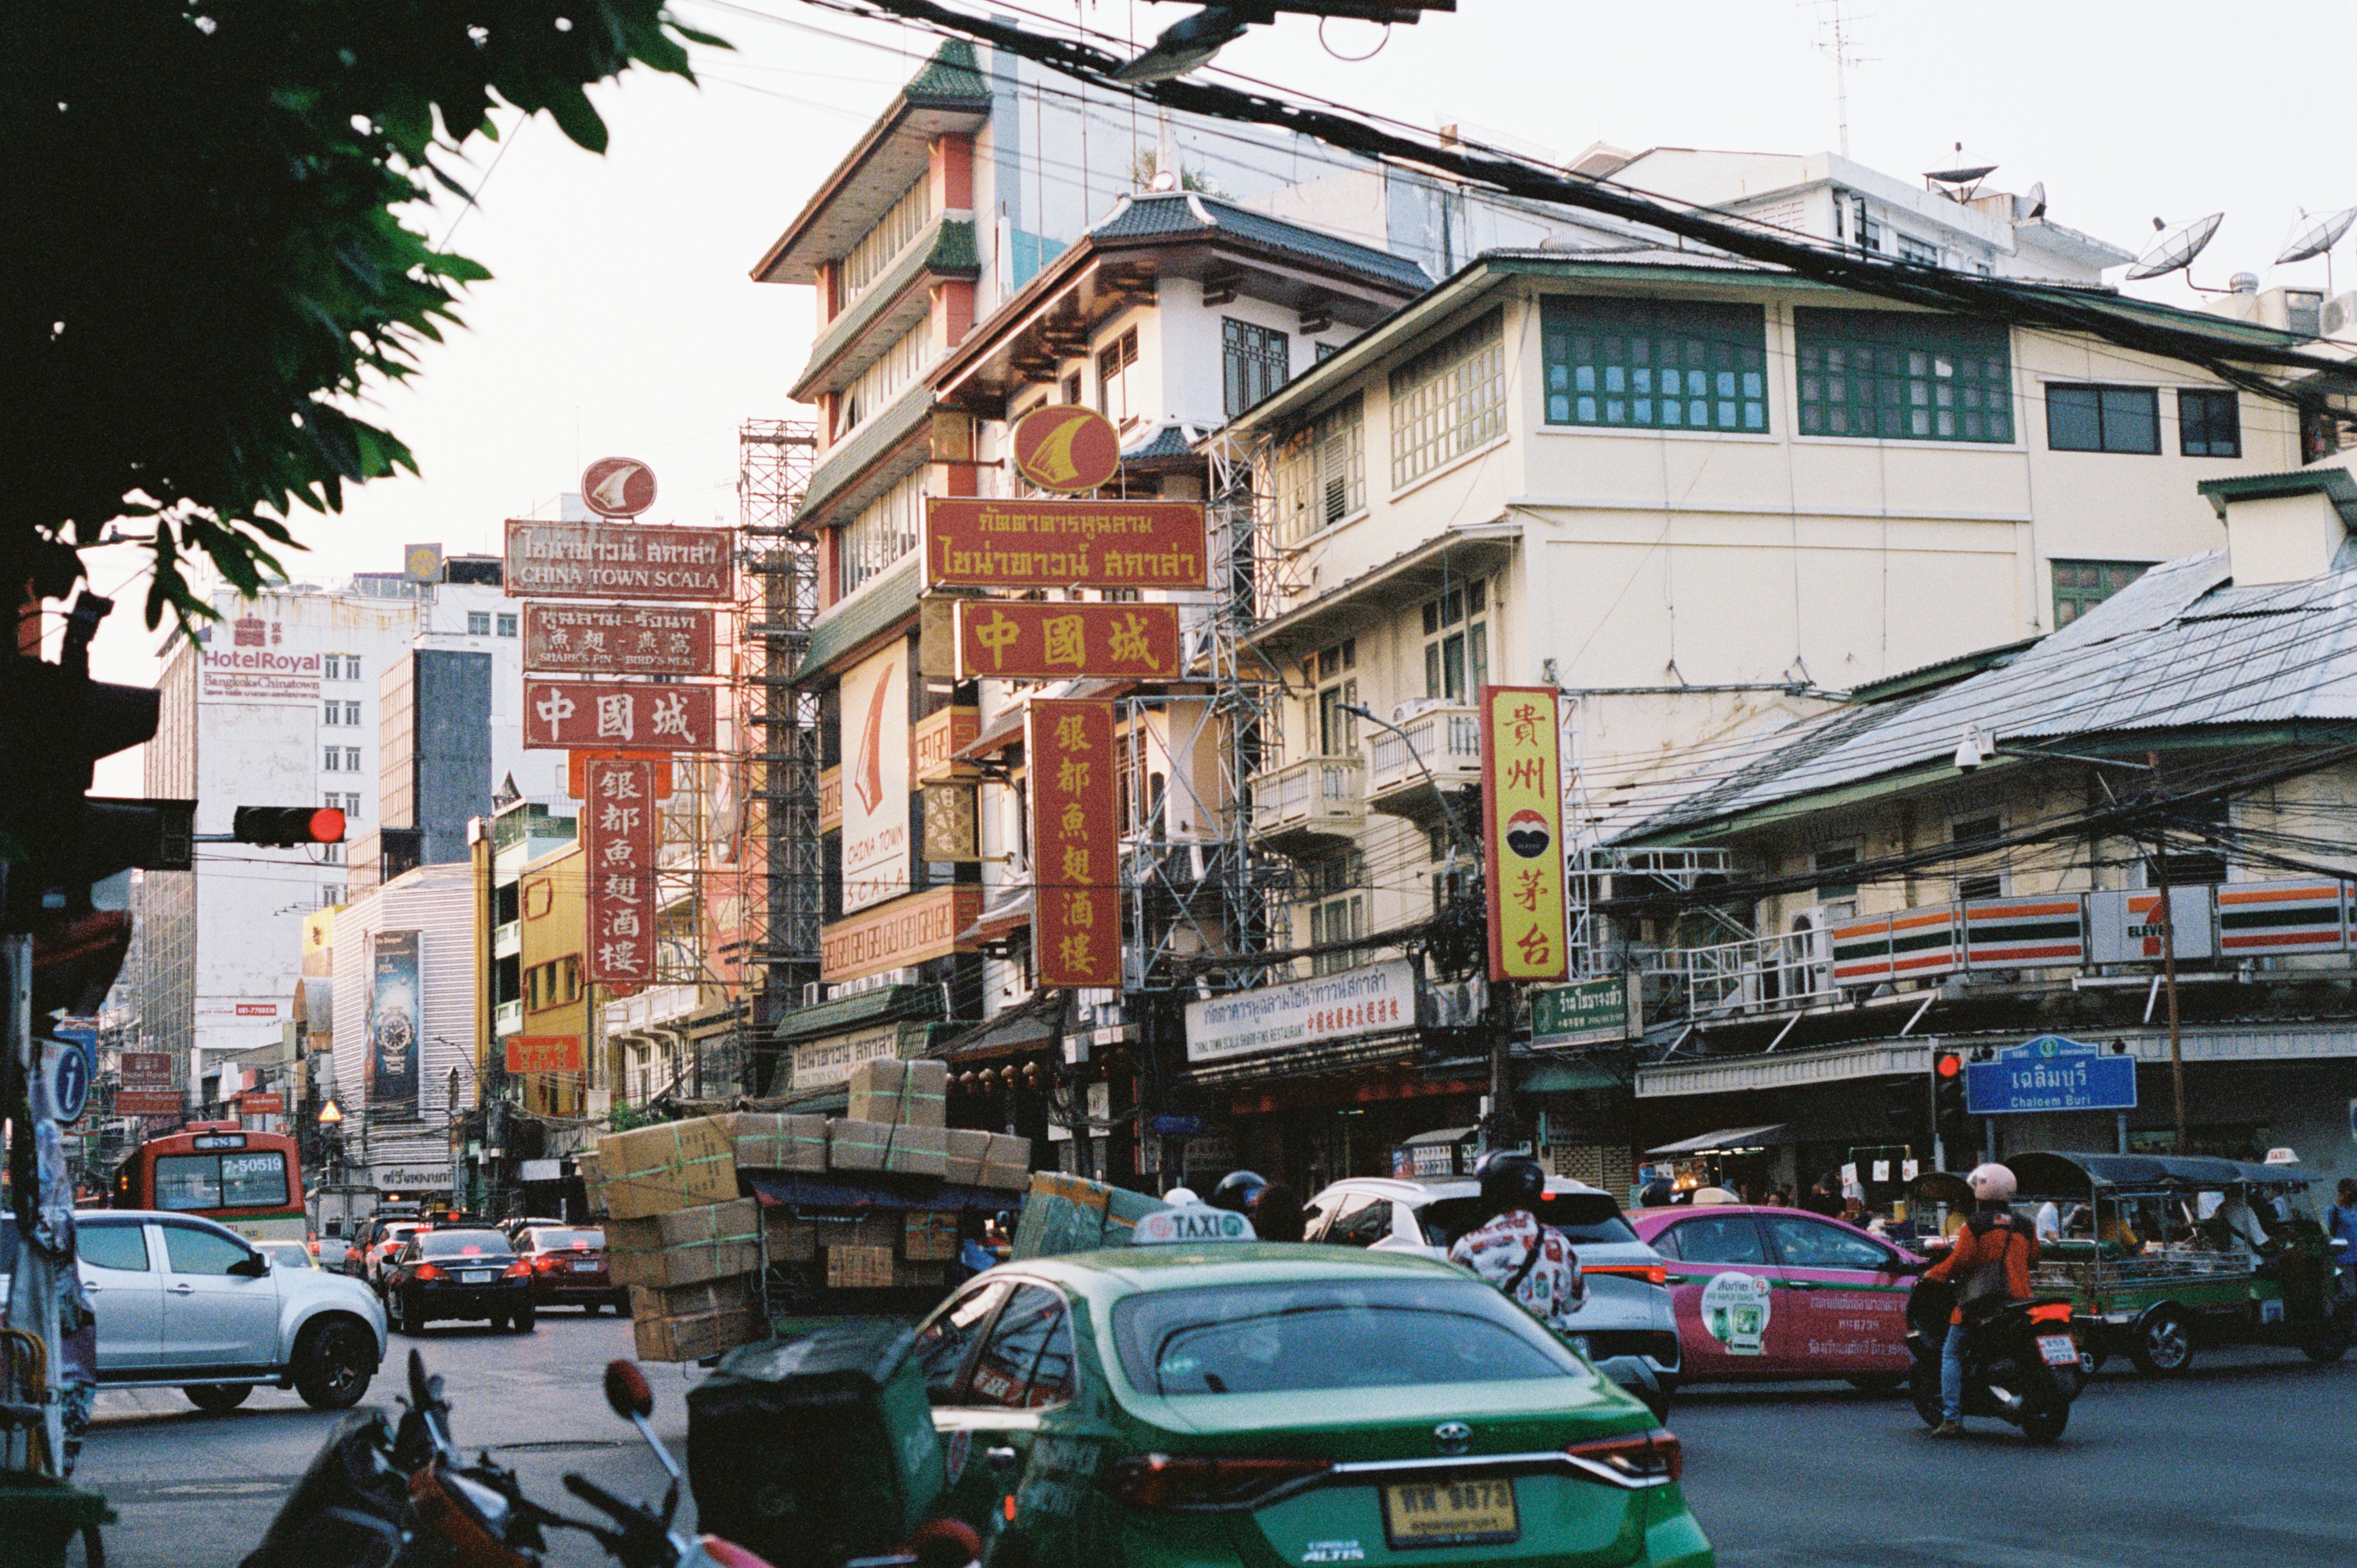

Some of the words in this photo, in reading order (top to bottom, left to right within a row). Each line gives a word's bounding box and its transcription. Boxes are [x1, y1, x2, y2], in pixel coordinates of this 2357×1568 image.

[521, 529, 637, 563] ไชน่าทาวน์
[647, 540, 717, 565] สกาล่า
[937, 536, 1089, 576] ไชน่าทาวน์
[1104, 542, 1196, 576] สกาล่า
[520, 566, 582, 585] CHINA
[590, 568, 650, 587] TOWN
[654, 570, 720, 589] SCALA
[976, 609, 1160, 670] 中國城
[592, 653, 612, 666] FIN
[667, 656, 697, 667] NEST
[535, 687, 697, 744] 中國城
[1502, 703, 1546, 800] 貴州
[847, 835, 876, 867] CHINA
[879, 822, 904, 853] TOWN
[1054, 714, 1097, 976] 銀都魚翅酒樓
[598, 770, 645, 974] 銀都魚翅酒樓
[847, 866, 905, 907] SCALA
[1512, 868, 1551, 967] 茅台
[2128, 922, 2174, 937] ELEVE
[2011, 1060, 2086, 1094] เฉลิมบุรี
[2011, 1096, 2061, 1108] Chaloem
[2066, 1094, 2091, 1106] Buri
[222, 1157, 282, 1174] 7-50519
[2271, 1151, 2286, 1160] TAXI
[1172, 1215, 1220, 1238] TAXI
[1302, 1549, 1365, 1563] ALTIS
